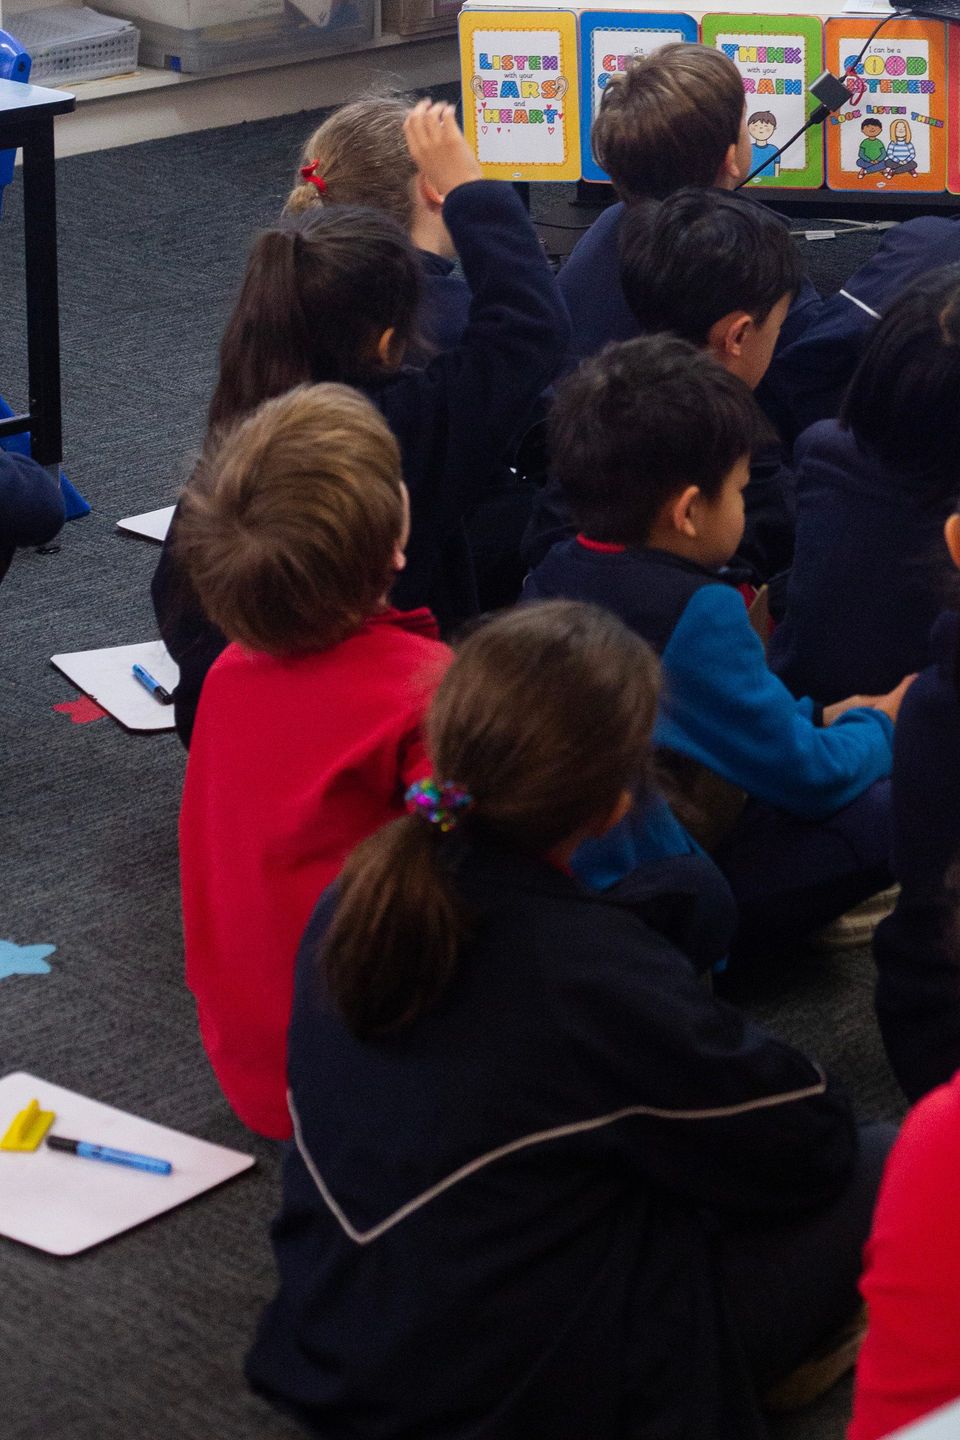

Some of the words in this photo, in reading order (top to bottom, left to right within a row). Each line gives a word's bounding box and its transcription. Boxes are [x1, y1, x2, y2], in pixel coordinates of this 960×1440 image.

[634, 46, 644, 54] Sit
[721, 43, 802, 64] THINK
[887, 46, 895, 54] be
[479, 53, 558, 71] LISTEN
[844, 54, 927, 76] GOOD
[519, 72, 534, 81] your
[762, 67, 777, 76] your
[482, 80, 557, 98] EARS
[741, 77, 802, 95] RAIN
[513, 100, 526, 108] and
[866, 105, 907, 114] LISTEN
[483, 108, 558, 124] HEART
[911, 112, 944, 128] THINK
